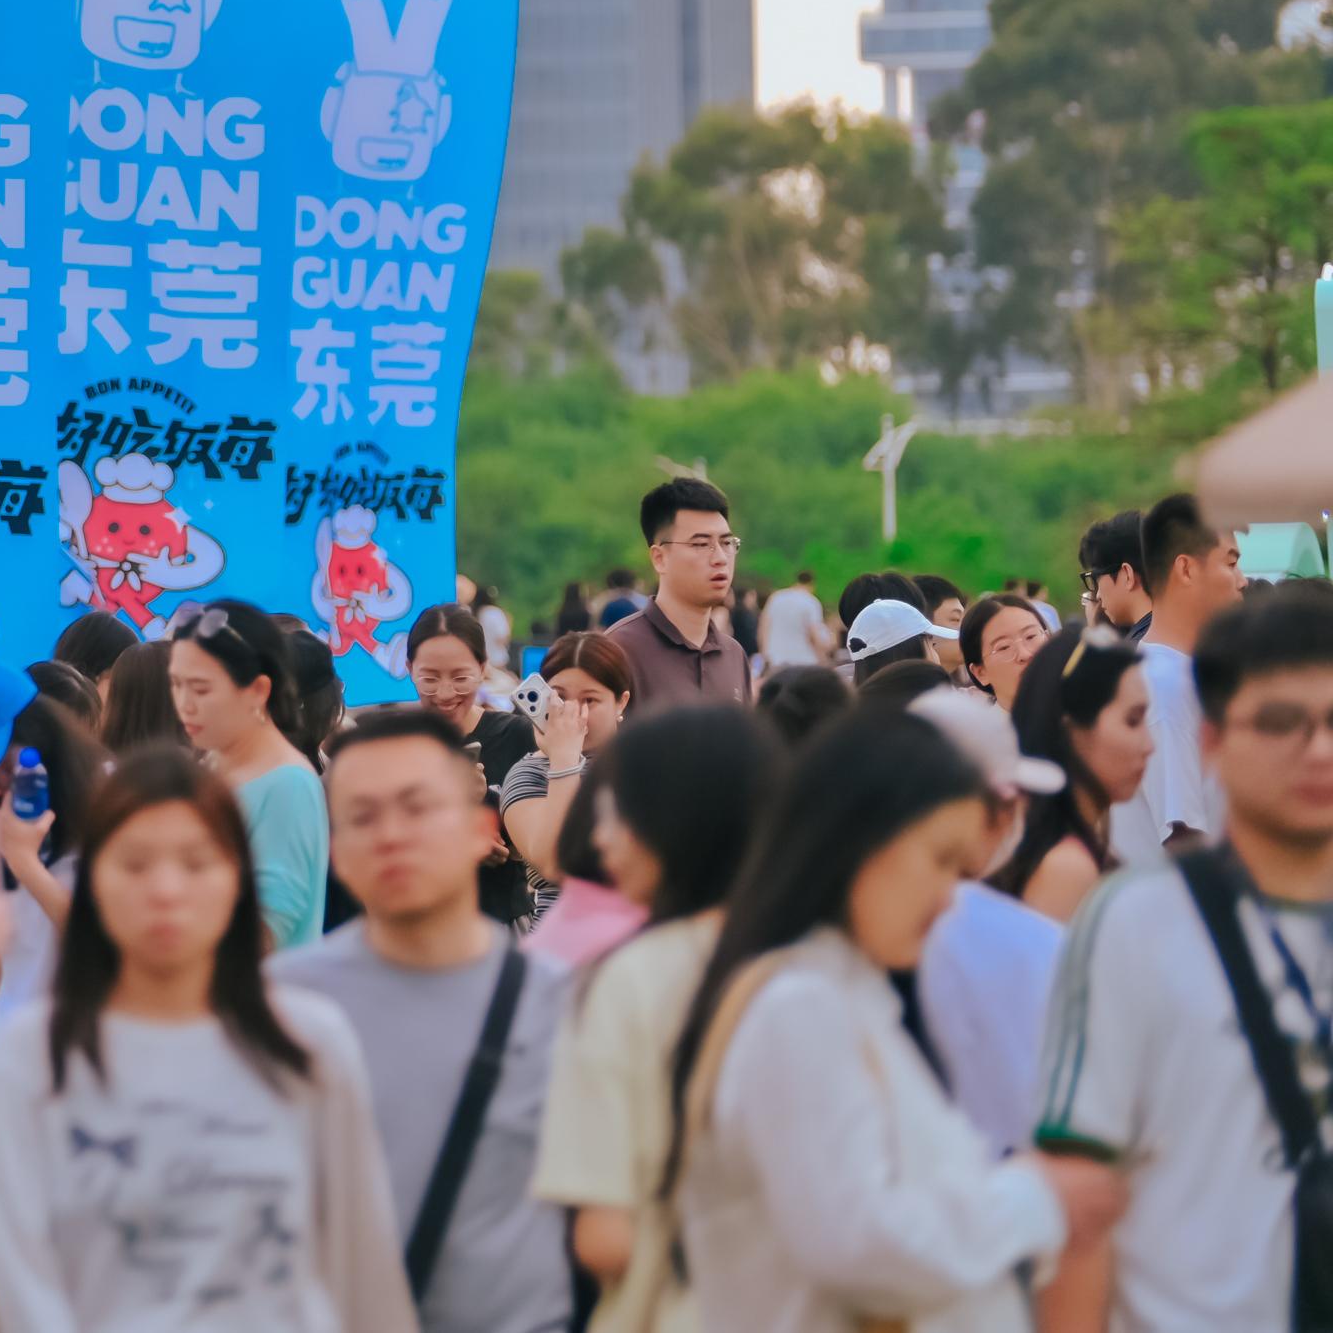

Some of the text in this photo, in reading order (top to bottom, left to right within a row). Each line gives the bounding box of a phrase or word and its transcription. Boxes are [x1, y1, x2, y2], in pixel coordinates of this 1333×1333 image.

[69, 86, 265, 162] ONG
[65, 158, 261, 232] UAN
[294, 194, 467, 254] DONG
[291, 256, 455, 314] GUAN
[85, 380, 121, 400] BON
[289, 318, 447, 428] 东莞
